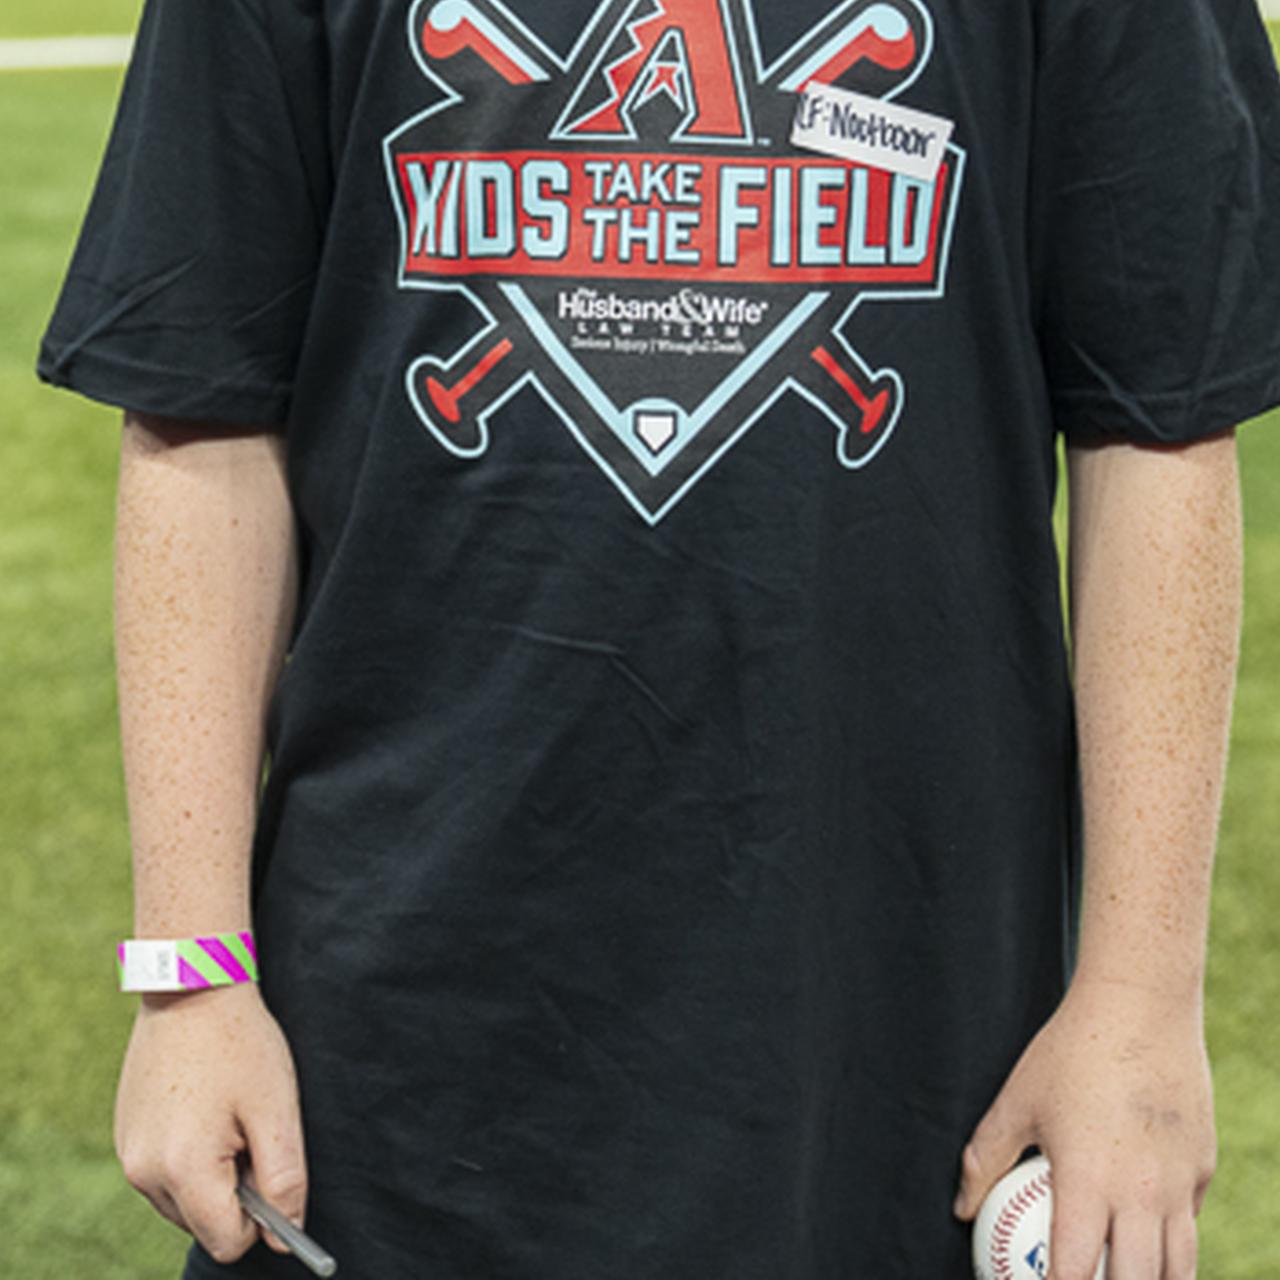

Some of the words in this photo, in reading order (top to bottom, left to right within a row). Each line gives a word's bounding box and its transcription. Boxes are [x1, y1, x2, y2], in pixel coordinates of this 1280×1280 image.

[584, 161, 702, 203] TAKE
[404, 160, 569, 259] KIDS
[583, 208, 701, 262] THE
[717, 166, 936, 265] FIELD
[577, 322, 634, 335] LAW
[662, 324, 739, 337] TEAM
